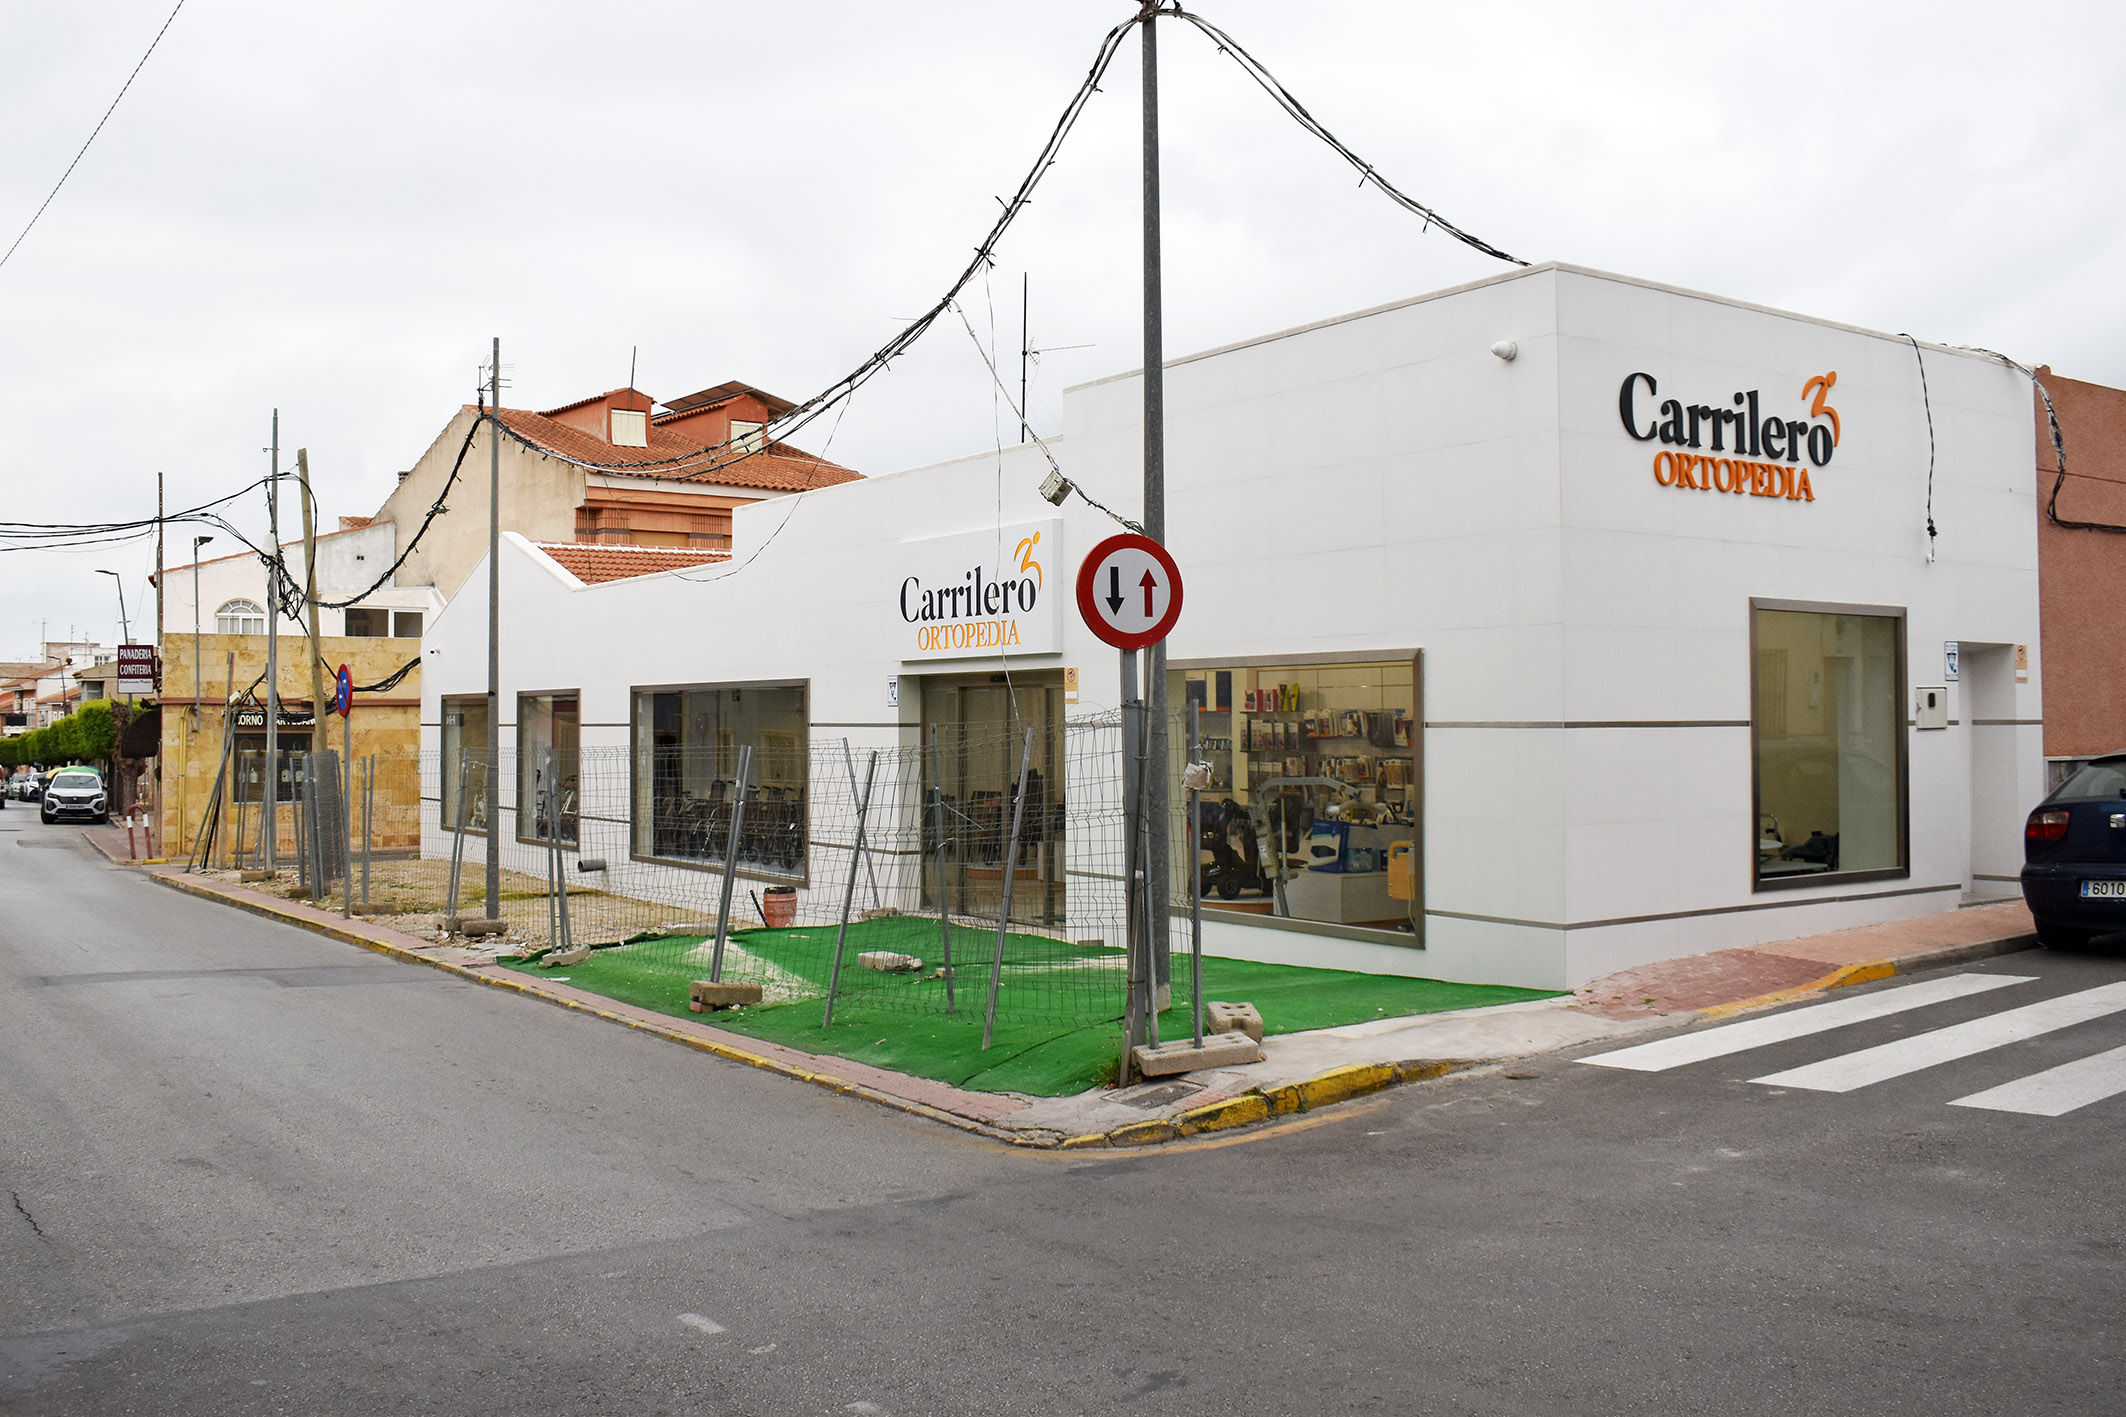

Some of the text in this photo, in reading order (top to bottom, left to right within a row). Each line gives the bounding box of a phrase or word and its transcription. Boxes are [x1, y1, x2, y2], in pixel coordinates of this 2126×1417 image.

[1619, 372, 1833, 466] Carrilero
[1653, 450, 1816, 501] ORTOPEDIA
[900, 565, 1036, 623] Carrilero
[917, 619, 1021, 651] ORTOPEDIA
[120, 648, 152, 660] PANADERIA
[120, 664, 152, 675] CONFITERIA
[2092, 882, 2125, 895] 6010
